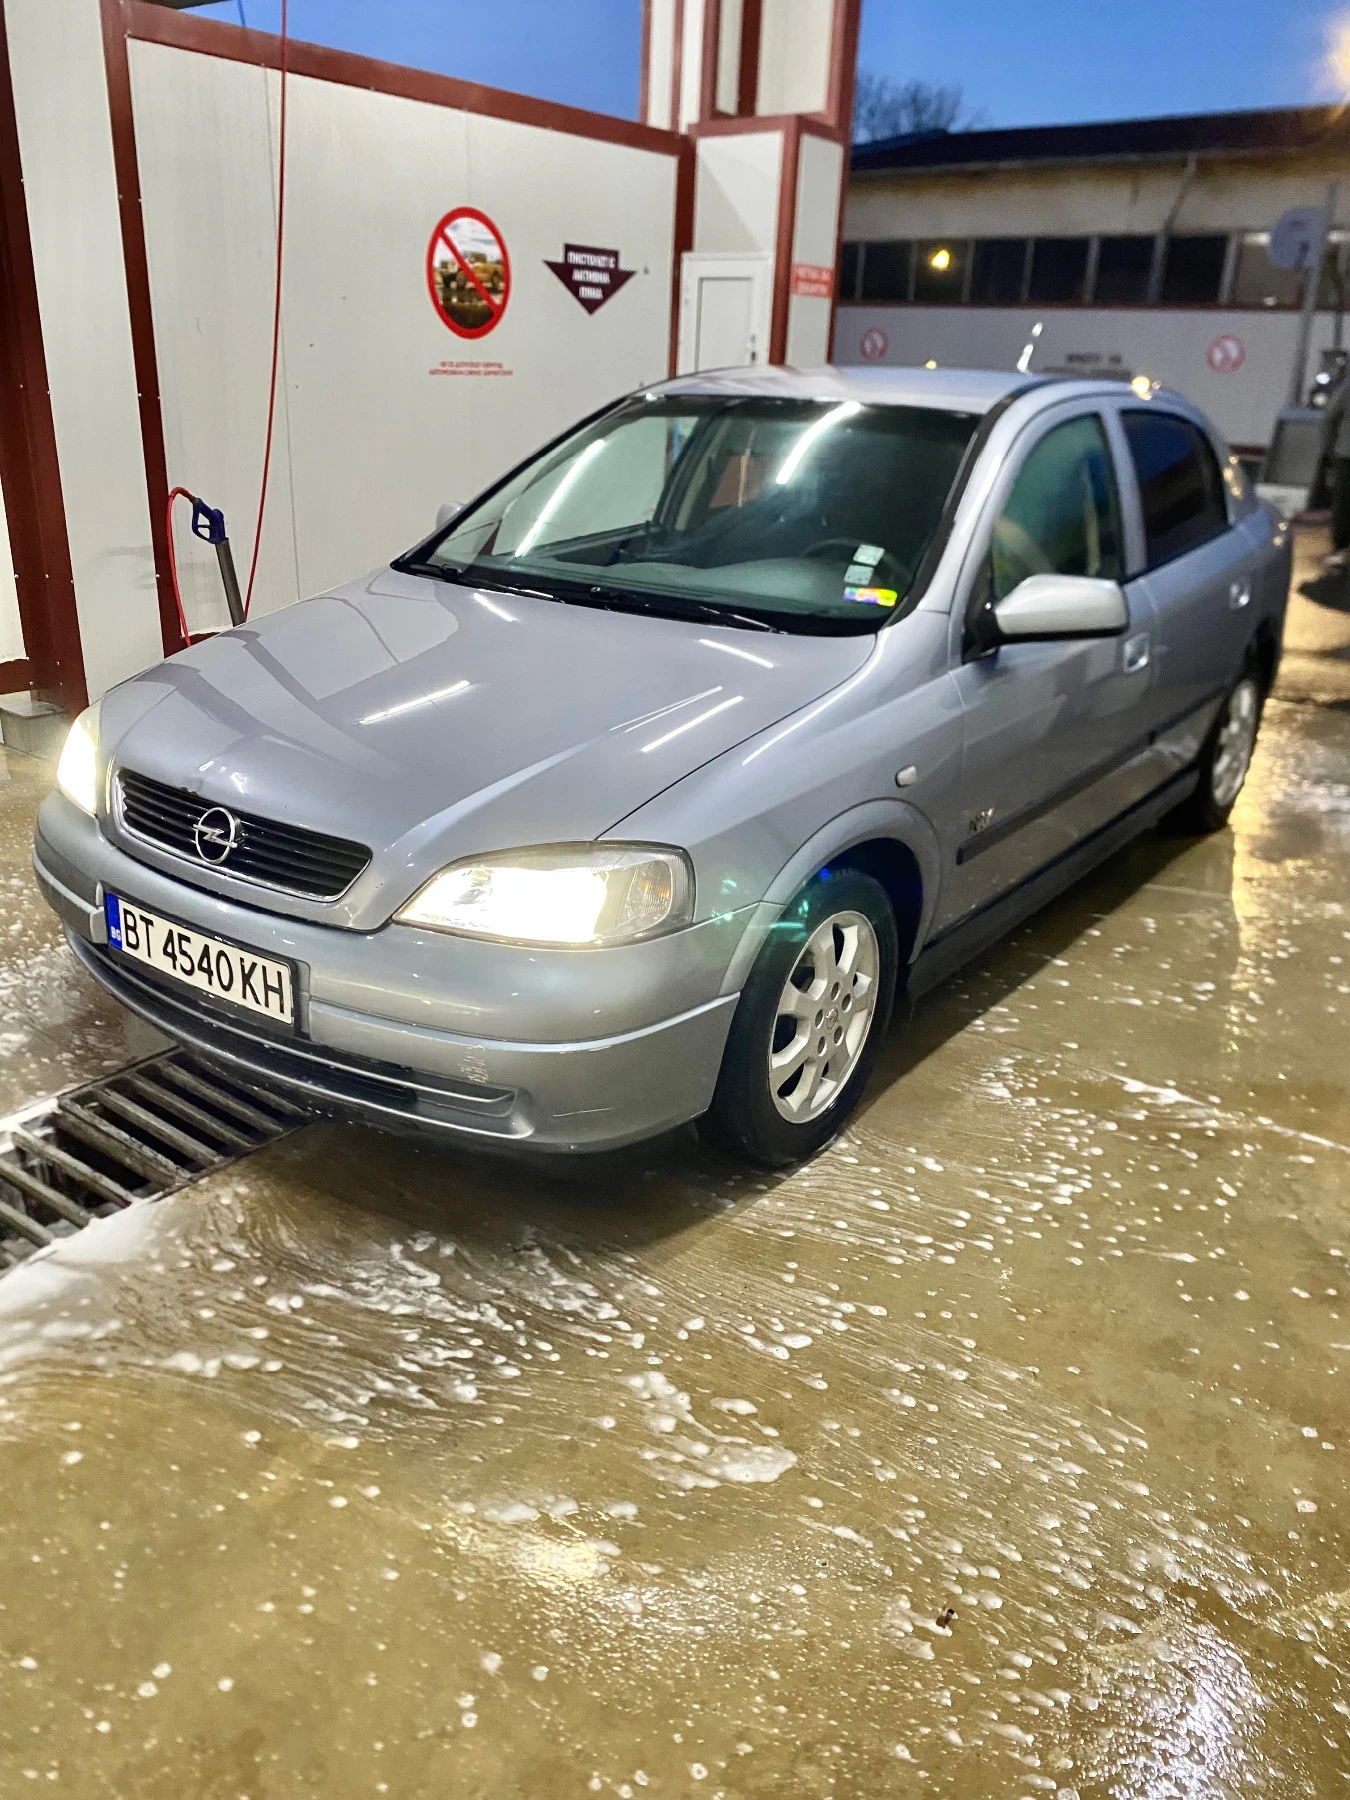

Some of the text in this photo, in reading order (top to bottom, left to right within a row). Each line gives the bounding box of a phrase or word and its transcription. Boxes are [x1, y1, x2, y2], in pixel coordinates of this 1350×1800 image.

[122, 908, 285, 1014] BT 4540 KH
